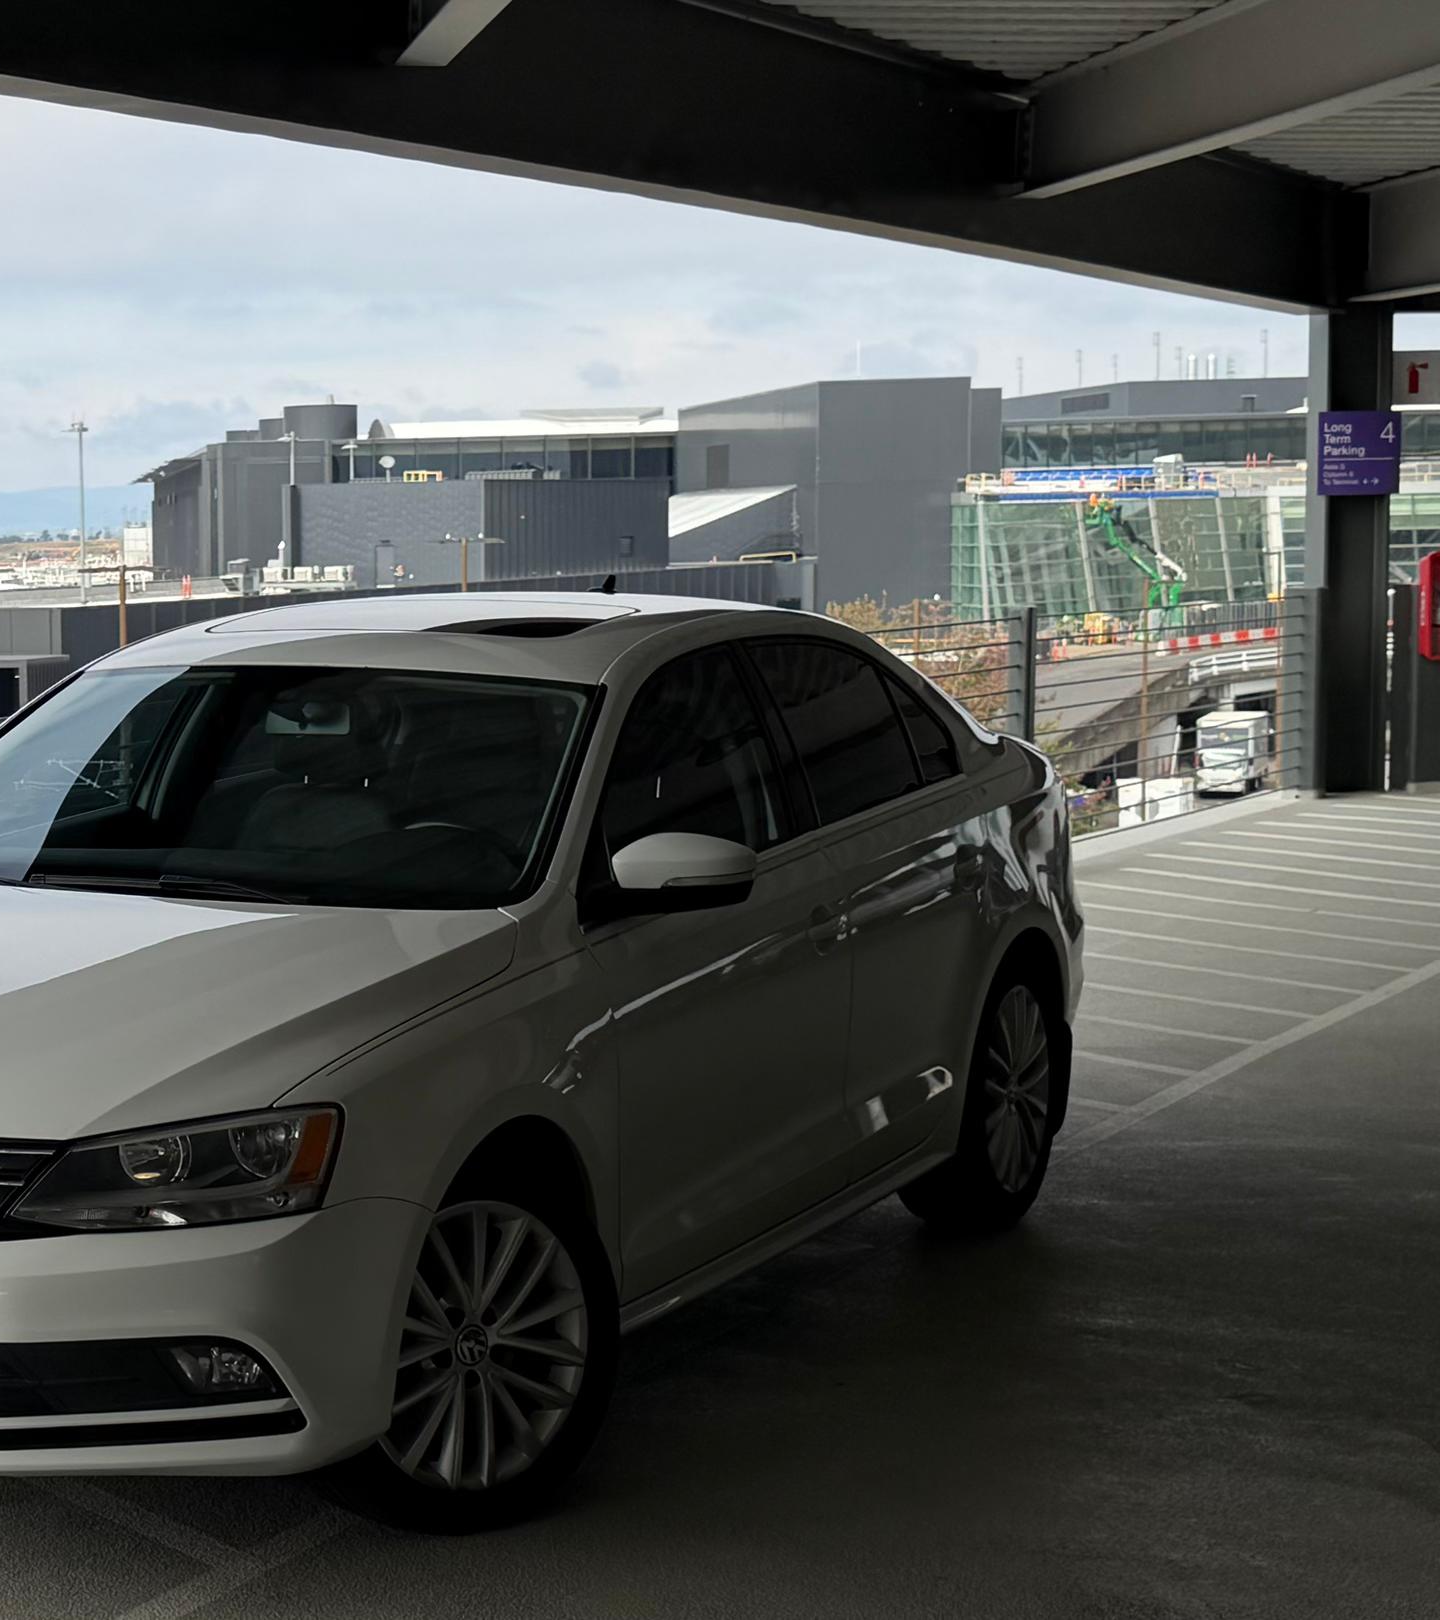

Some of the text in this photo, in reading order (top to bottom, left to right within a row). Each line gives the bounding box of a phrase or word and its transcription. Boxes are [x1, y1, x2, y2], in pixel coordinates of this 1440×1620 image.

[1324, 422, 1352, 434] Long
[1380, 421, 1396, 443] 4
[1323, 434, 1351, 444] Term
[1323, 445, 1366, 457] Parking
